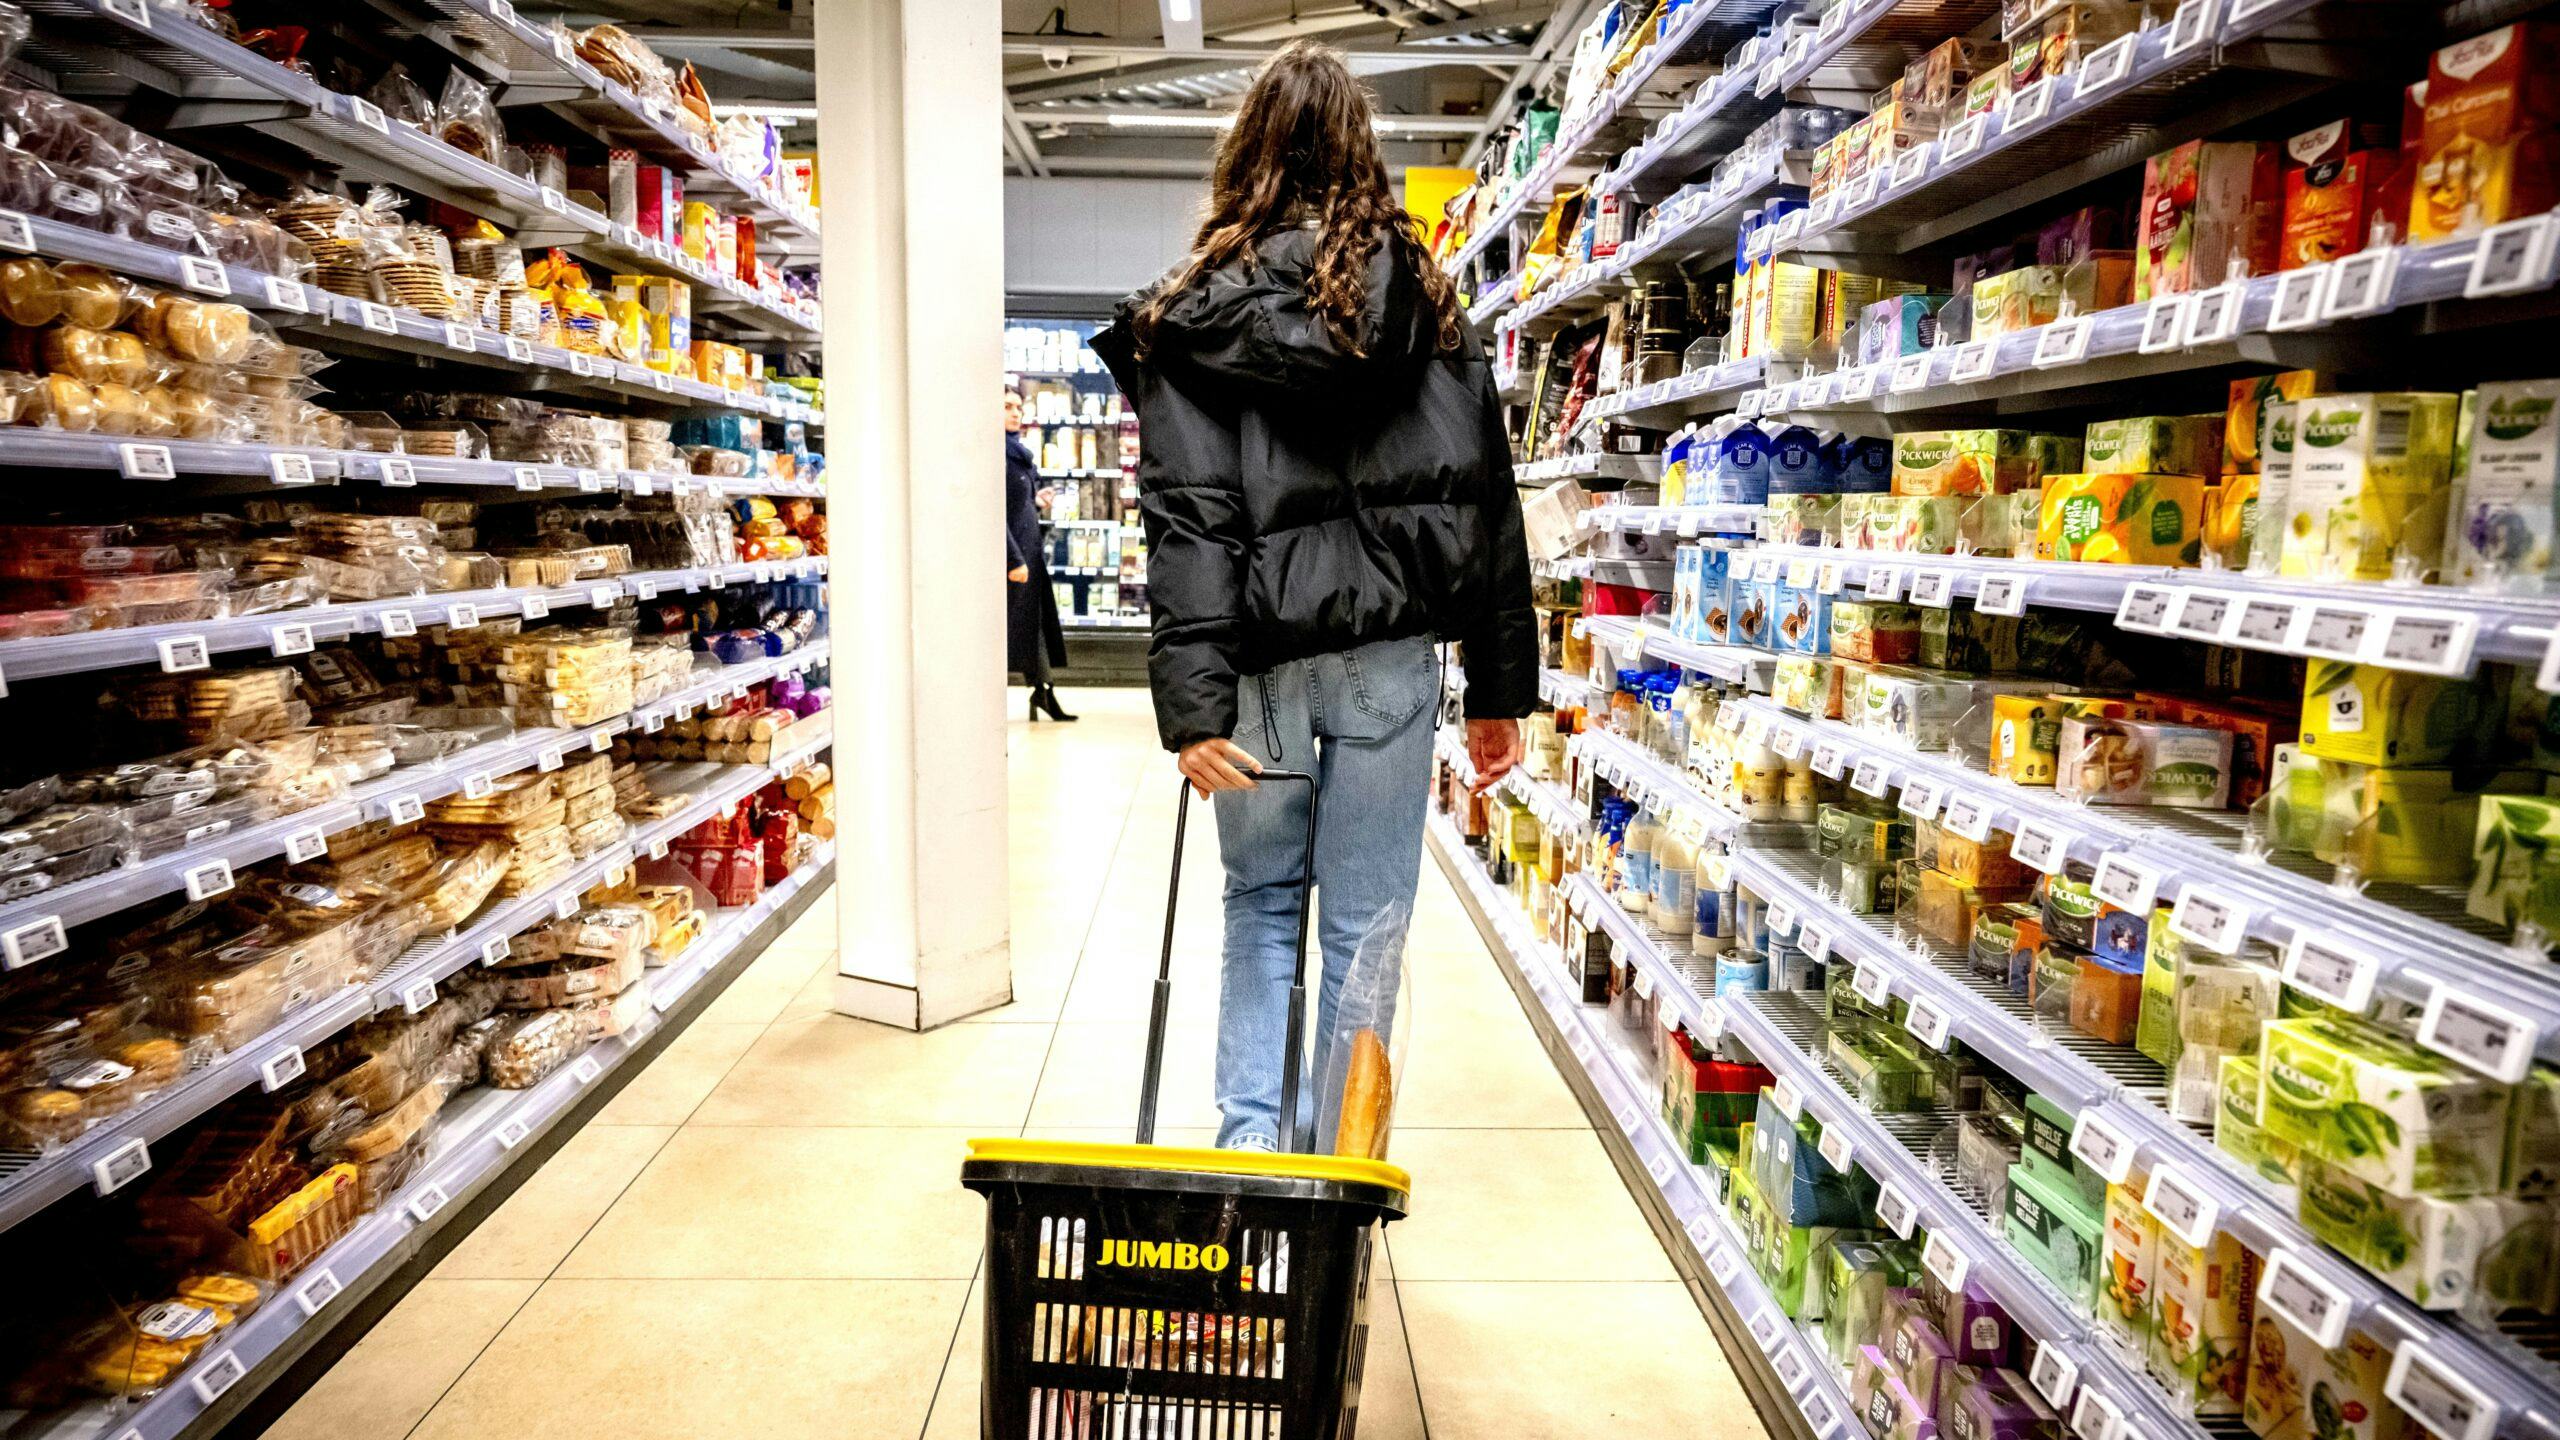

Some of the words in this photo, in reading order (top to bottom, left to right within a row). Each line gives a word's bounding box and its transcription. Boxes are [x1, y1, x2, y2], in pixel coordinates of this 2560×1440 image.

[1898, 449, 1953, 462] PICKWICK
[2088, 439, 2122, 452] PICKWICK
[2148, 772, 2218, 788] PICKWICK
[1817, 819, 1847, 834] PICKWICK
[2048, 883, 2102, 914] PICKWICK
[1974, 924, 2015, 950] PICKWICK
[2059, 919, 2083, 934] DUTCH
[2035, 958, 2072, 982] PICKW
[2033, 1117, 2063, 1147] ENGELSE
[2034, 1134, 2059, 1160] MELANGE
[2014, 1188, 2040, 1220] ENGELSE
[2015, 1204, 2038, 1232] MELANGE
[1097, 1239, 1230, 1273] JUMBO
[1870, 1389, 1880, 1420] GREY
[1877, 1392, 1888, 1421] EARL
